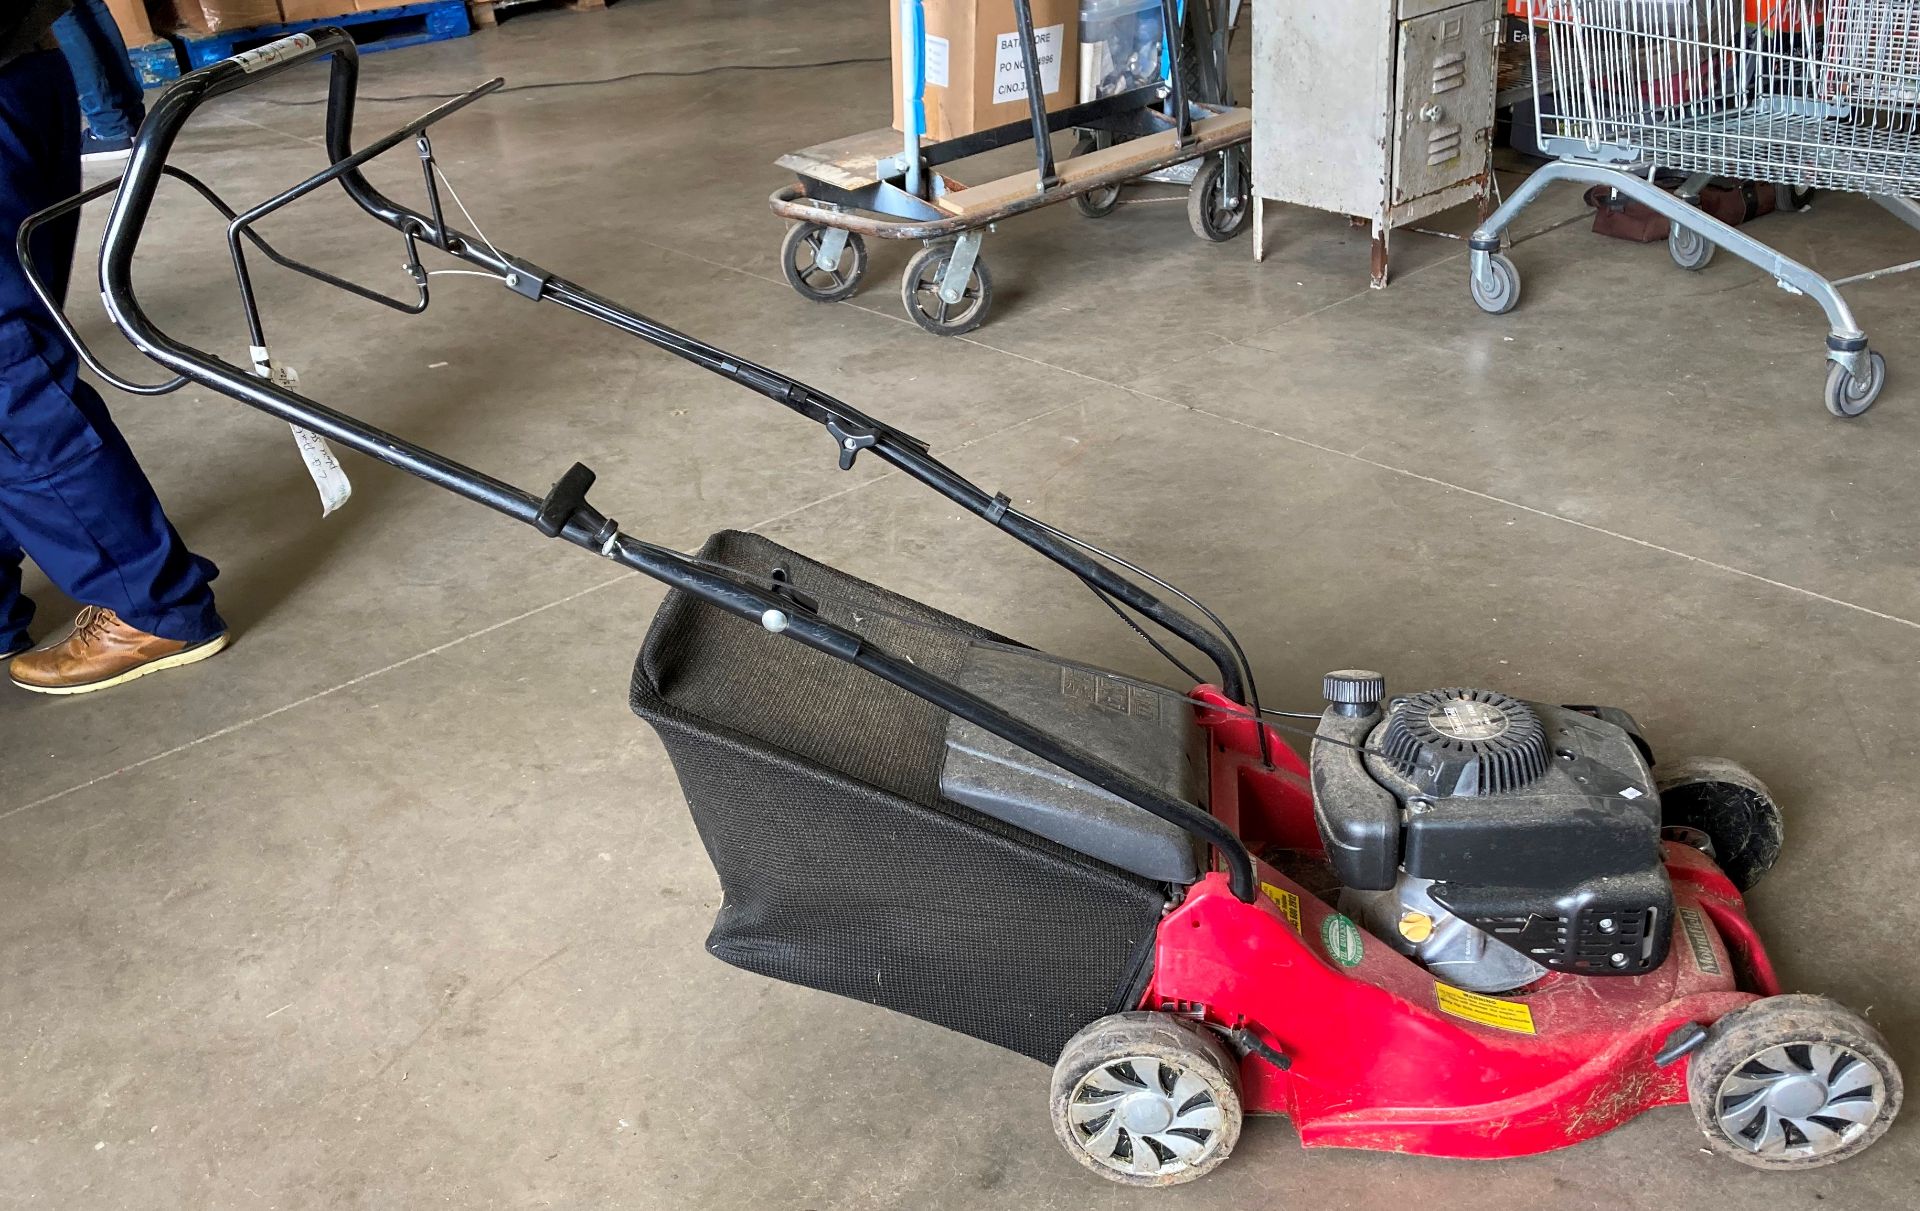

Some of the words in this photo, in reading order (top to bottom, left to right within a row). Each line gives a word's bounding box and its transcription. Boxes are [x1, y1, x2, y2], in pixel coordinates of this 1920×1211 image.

[1001, 33, 1050, 49] BATORE
[1513, 30, 1537, 43] Eai
[999, 62, 1012, 73] PO
[998, 82, 1027, 95] C/NO.3
[1681, 909, 1718, 974] Mountfield
[1462, 993, 1497, 1005] WARNING
